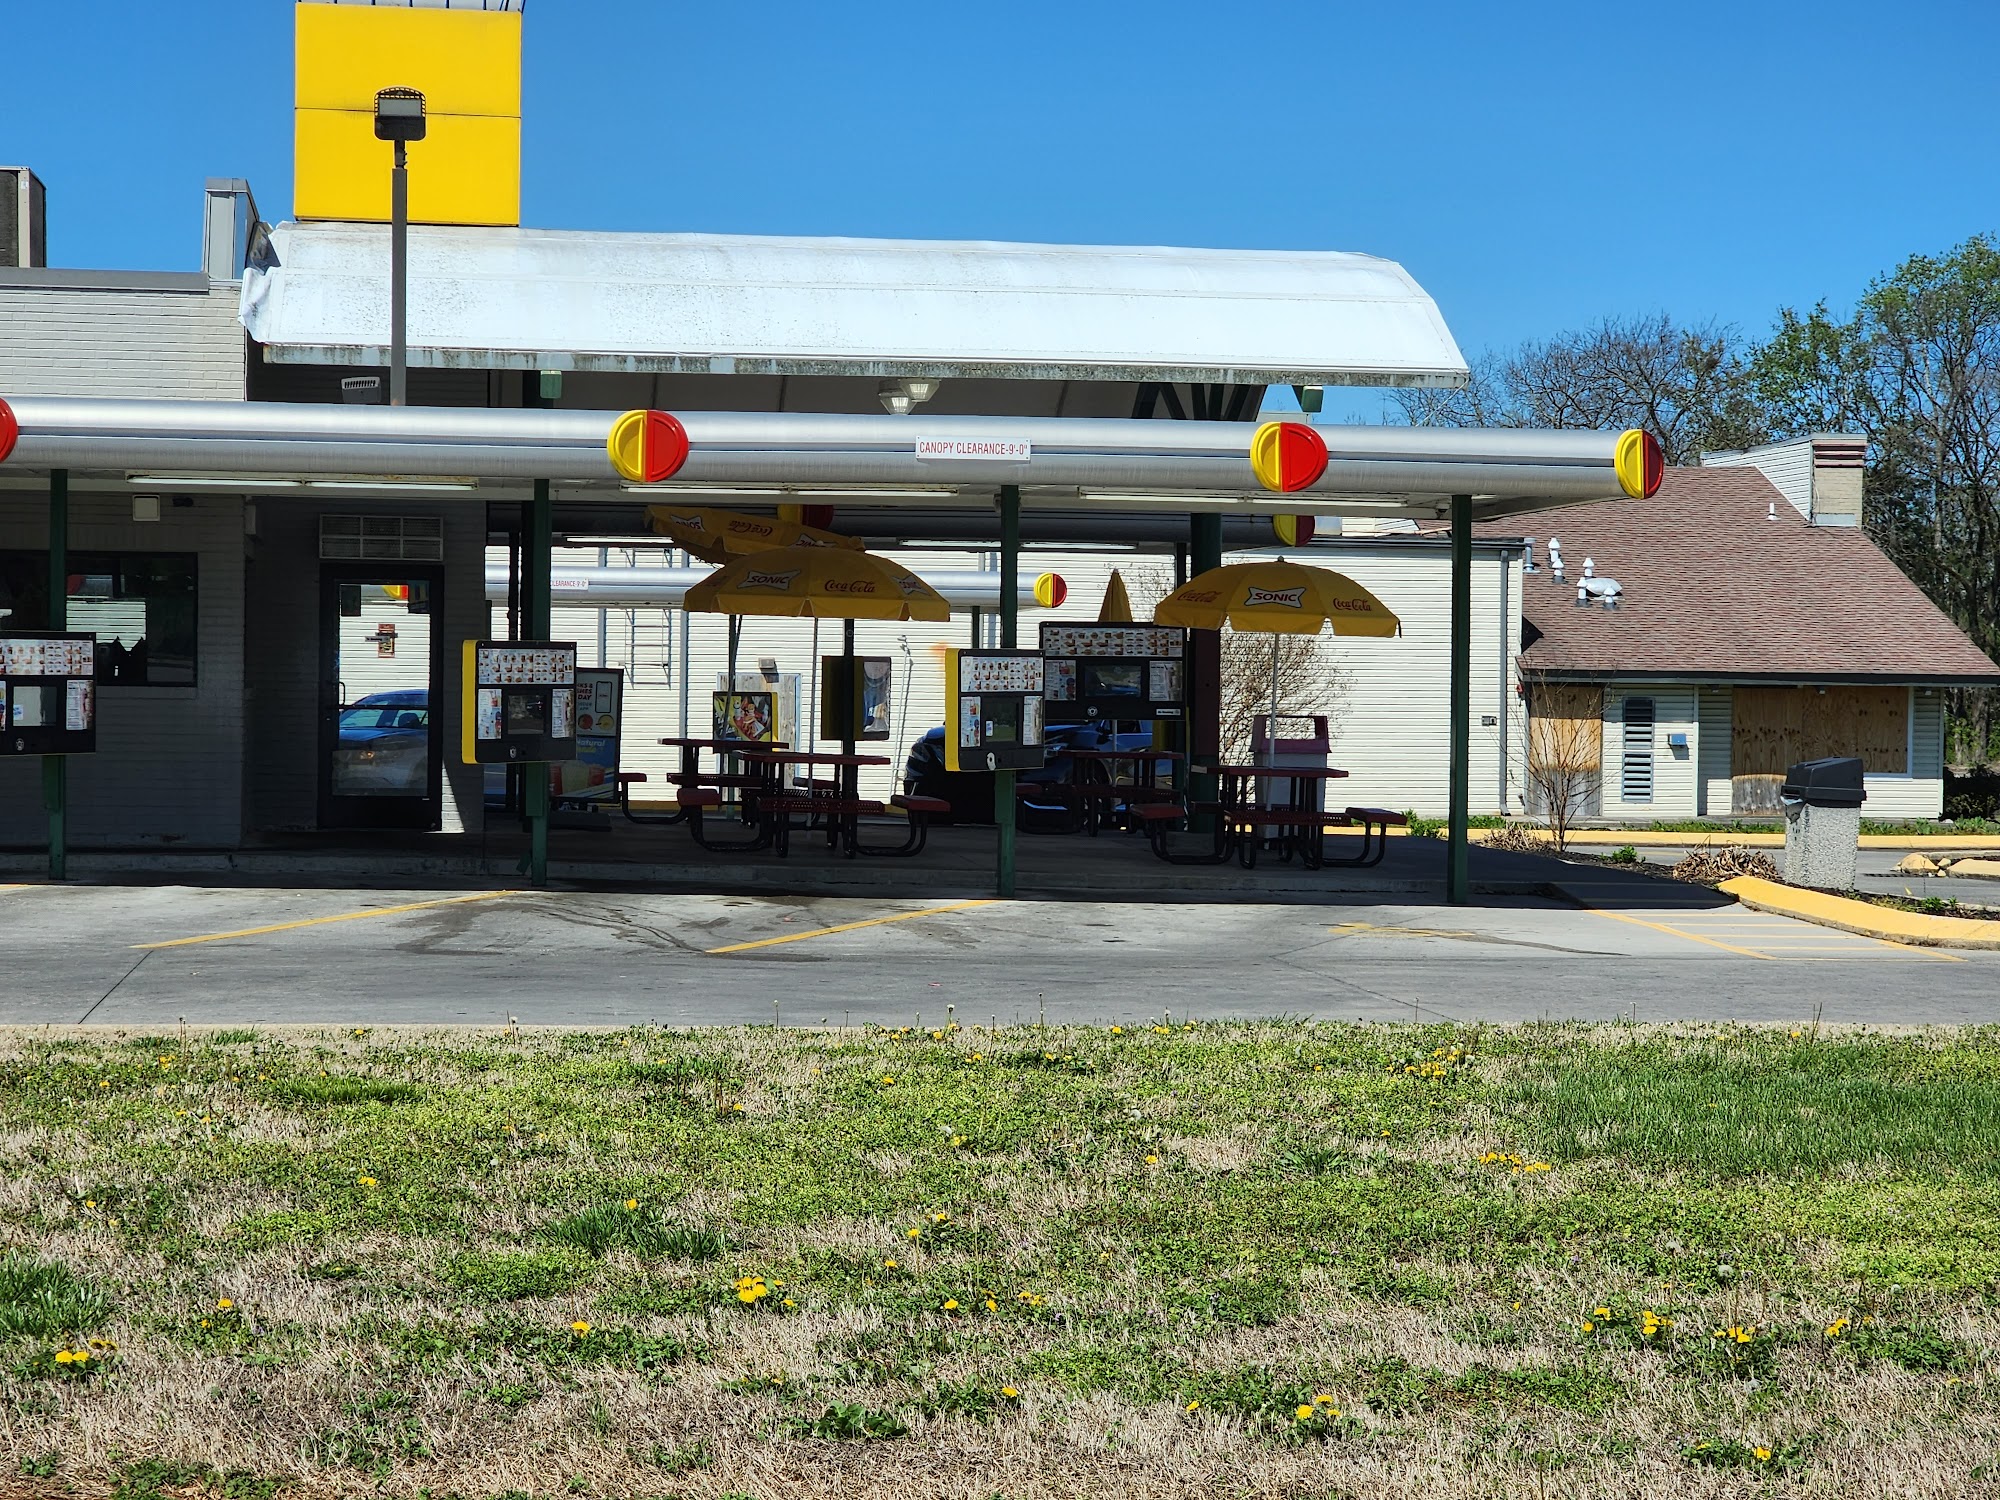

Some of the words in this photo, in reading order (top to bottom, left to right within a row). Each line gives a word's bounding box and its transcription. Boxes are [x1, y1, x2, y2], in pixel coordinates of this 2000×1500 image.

[919, 441, 954, 454] CANOPY
[747, 575, 790, 584] SONIC
[1253, 592, 1297, 602] SONIC
